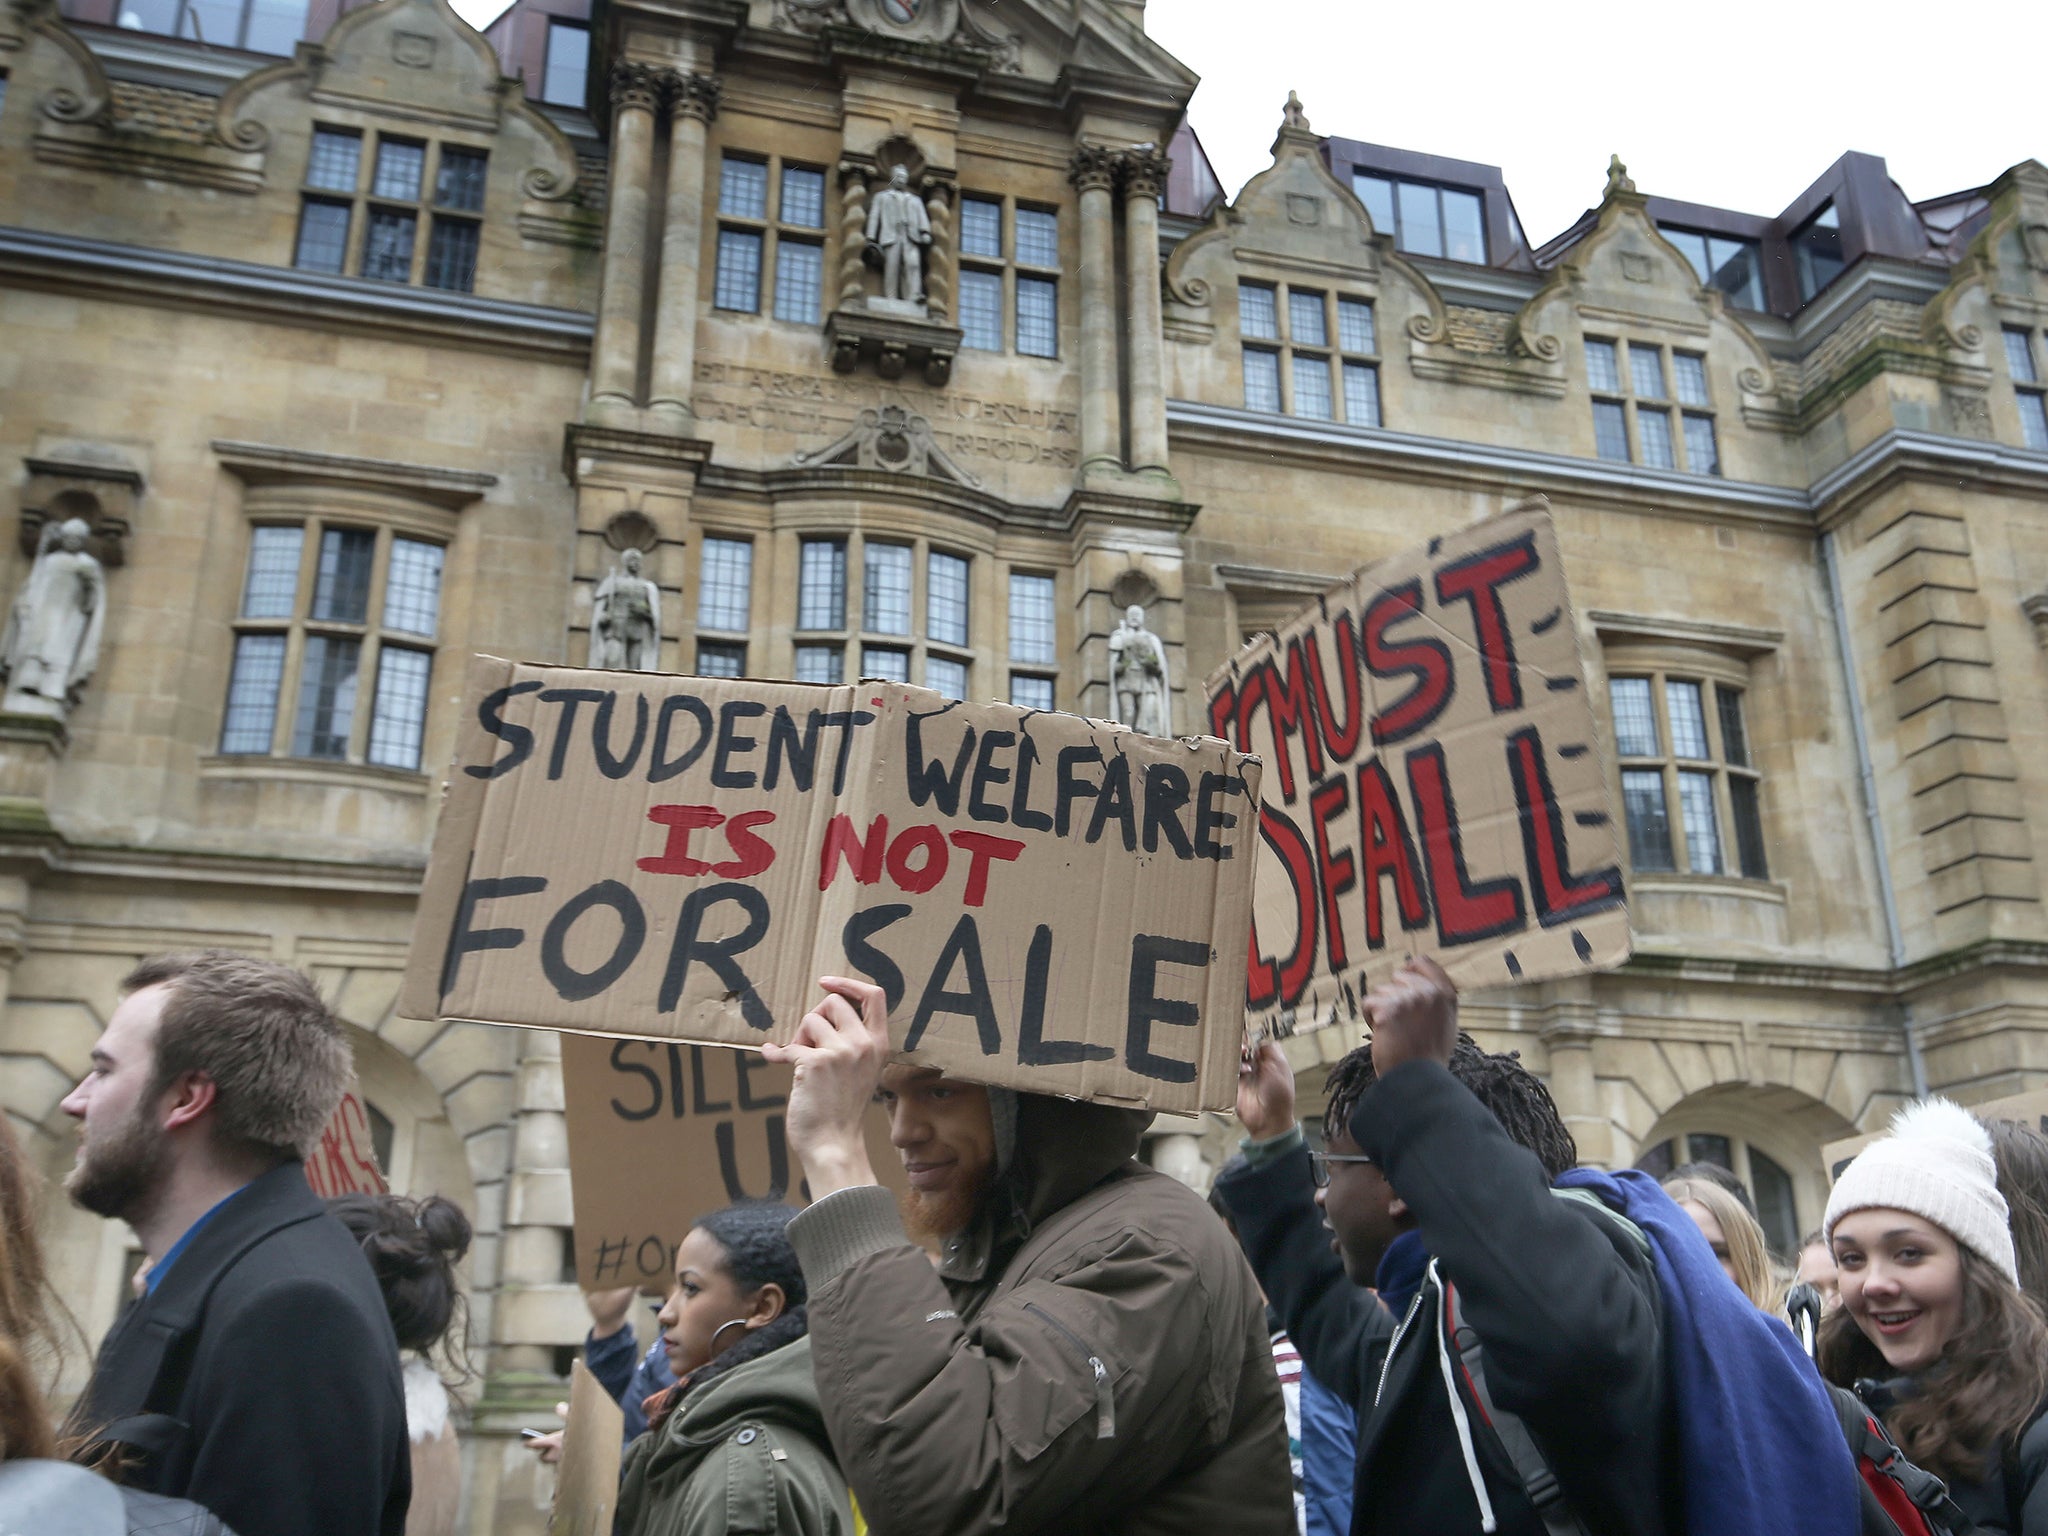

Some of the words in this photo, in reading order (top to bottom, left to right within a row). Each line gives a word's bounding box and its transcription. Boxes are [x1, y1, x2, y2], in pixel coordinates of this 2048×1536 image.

[951, 431, 1078, 469] RHODES
[1262, 529, 1540, 805] MUST
[464, 681, 876, 796] STUDENT
[906, 706, 1247, 861] WELFARE
[636, 805, 777, 880] IS
[818, 813, 1027, 908] NOT
[1309, 725, 1627, 975] FALL
[439, 875, 775, 1032] FOR
[841, 903, 1210, 1084] SALE
[610, 1040, 787, 1121] SILE
